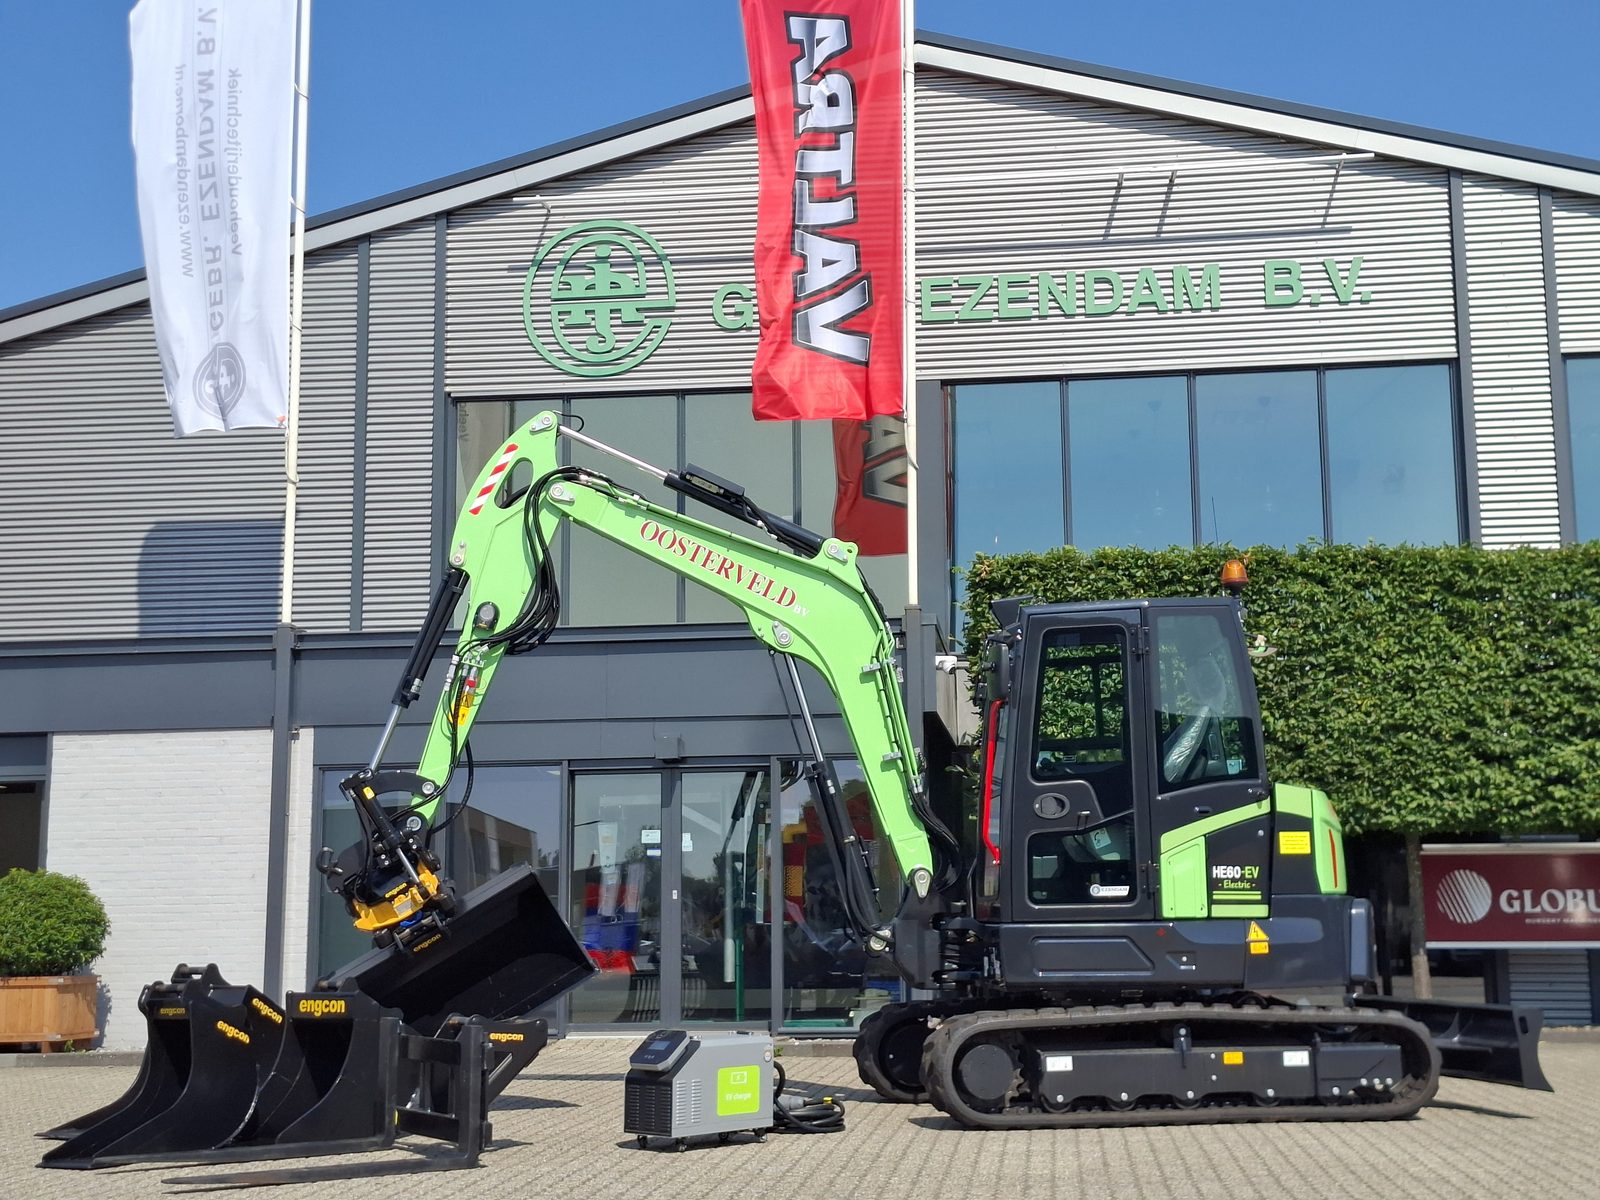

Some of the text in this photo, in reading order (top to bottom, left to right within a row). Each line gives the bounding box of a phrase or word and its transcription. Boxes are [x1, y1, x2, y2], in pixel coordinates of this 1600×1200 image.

[920, 256, 1372, 322] EZENDAM B.V.
[640, 519, 811, 617] OOSTERVELD BV
[384, 882, 408, 898] engcon
[1223, 879, 1252, 889] Electric
[413, 933, 442, 952] engcon
[160, 1007, 186, 1016] engcon
[252, 997, 283, 1024] engcon
[299, 998, 346, 1017] engcon
[216, 1019, 250, 1044] engcon
[489, 1032, 524, 1042] engcon
